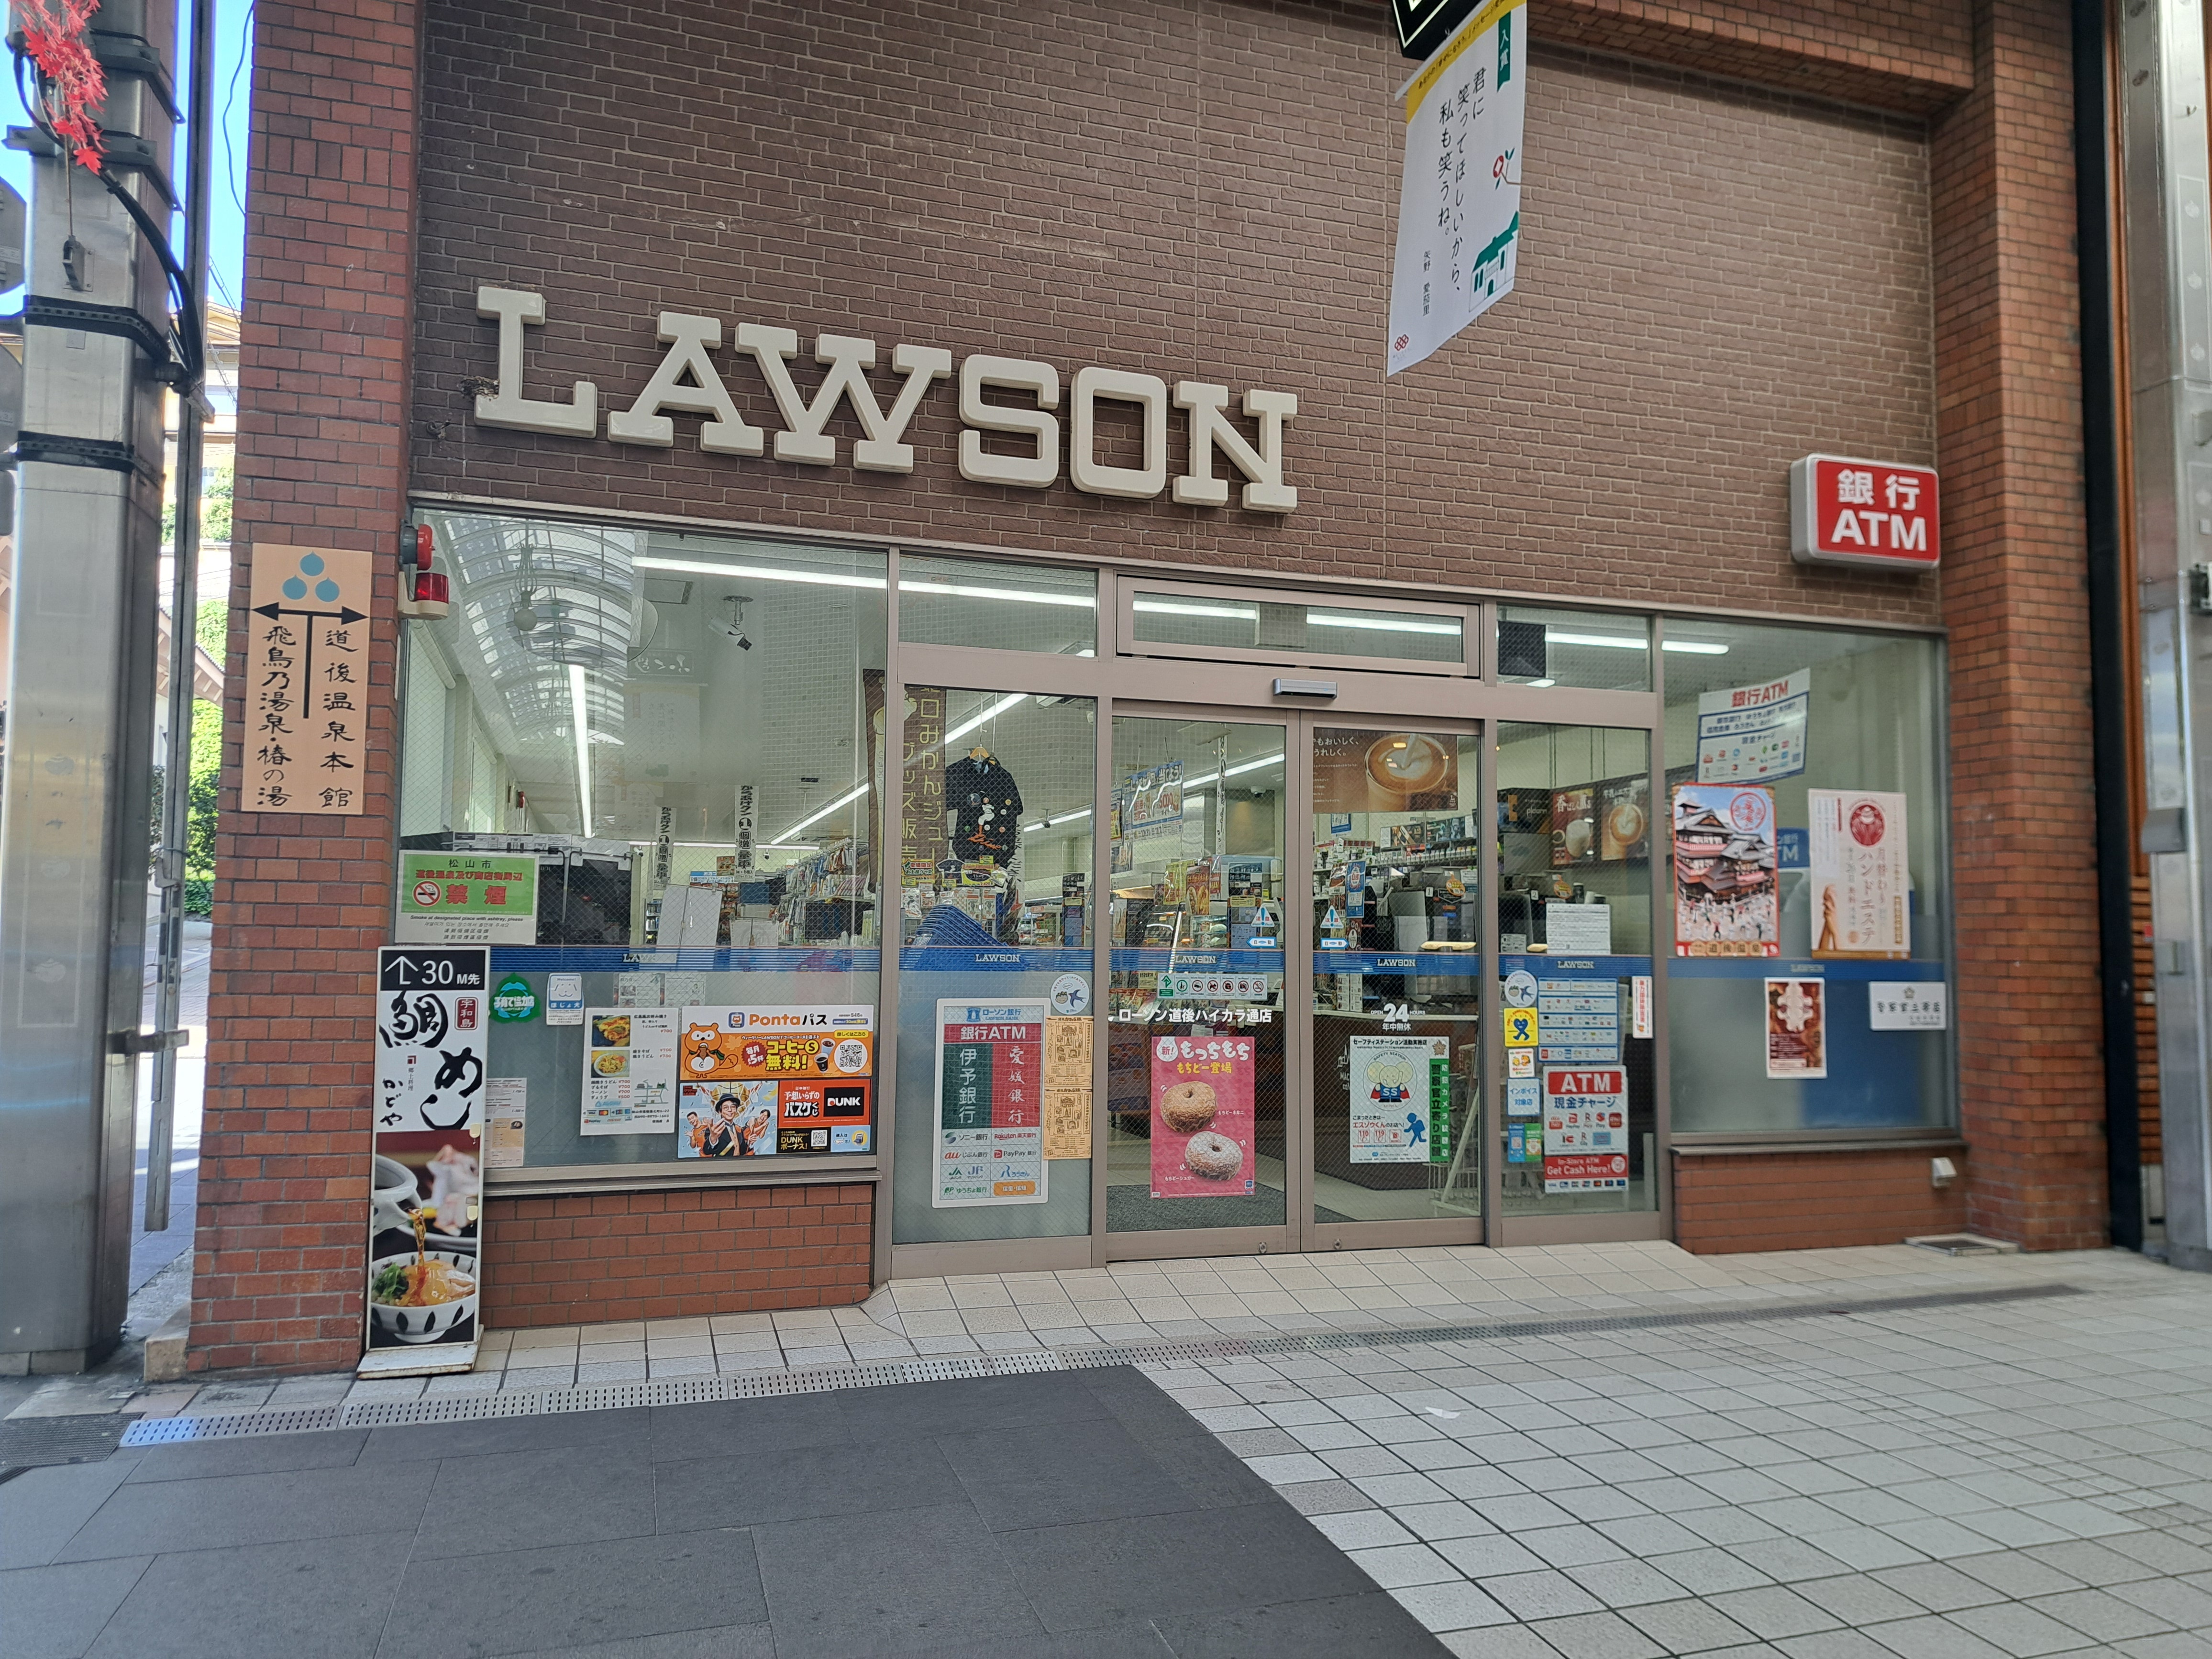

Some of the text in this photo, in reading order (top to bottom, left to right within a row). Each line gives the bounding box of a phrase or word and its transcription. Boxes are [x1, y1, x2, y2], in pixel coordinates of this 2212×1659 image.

[1473, 67, 1486, 120] 君に
[1438, 99, 1454, 235] 私も笑うね。
[1451, 84, 1471, 291] 笑ってほしいから、
[474, 286, 1298, 513] LAWSON
[1838, 469, 1920, 510] 銀行
[1831, 509, 1927, 551] ATM
[1731, 680, 1789, 708] 銀行ATM
[256, 626, 296, 807] 飛鳥乃湯泉・椿の湯
[319, 630, 359, 808] 道後温泉本館
[449, 859, 492, 869] 松山市
[415, 870, 523, 881] 道後温泉及び商店街周辺
[446, 884, 507, 905] 禁煙
[975, 954, 1020, 963] LAWSON
[1175, 955, 1216, 964] LAWSON
[1377, 959, 1416, 967] LAWSON
[1557, 961, 1594, 969] LAWSON
[421, 961, 480, 985] 30 M先
[493, 995, 535, 1008] 子育て協力店
[461, 998, 474, 1028] 宇和島
[749, 1013, 828, 1026] Pontaパス
[1118, 1008, 1272, 1023] ローソン道後ハイカラ通店
[1383, 1003, 1409, 1022] 24
[961, 1026, 1026, 1040] 銀行ATM
[1382, 1022, 1411, 1031] 年中無休
[746, 1045, 760, 1055] 毎月
[1161, 1046, 1174, 1056] 新!
[1179, 1040, 1250, 1061] もっちもち
[379, 990, 482, 1130] 鯛 めし
[765, 1054, 807, 1071] 無料!
[1176, 1062, 1233, 1075] もちどー登場
[407, 1067, 415, 1091] 郷土料理
[960, 1048, 977, 1124] 伊予銀行
[1007, 1046, 1025, 1125] 愛媛銀行
[1560, 1073, 1611, 1093] ATM
[784, 1090, 820, 1100] 予想いらずの
[1382, 1088, 1398, 1096] SS
[379, 1078, 404, 1127] かどや
[784, 1101, 819, 1117] バスケくじ
[827, 1096, 861, 1107] DUNK
[1554, 1095, 1617, 1109] 現金チャージ
[1547, 1164, 1611, 1175] Get Cash Here!
